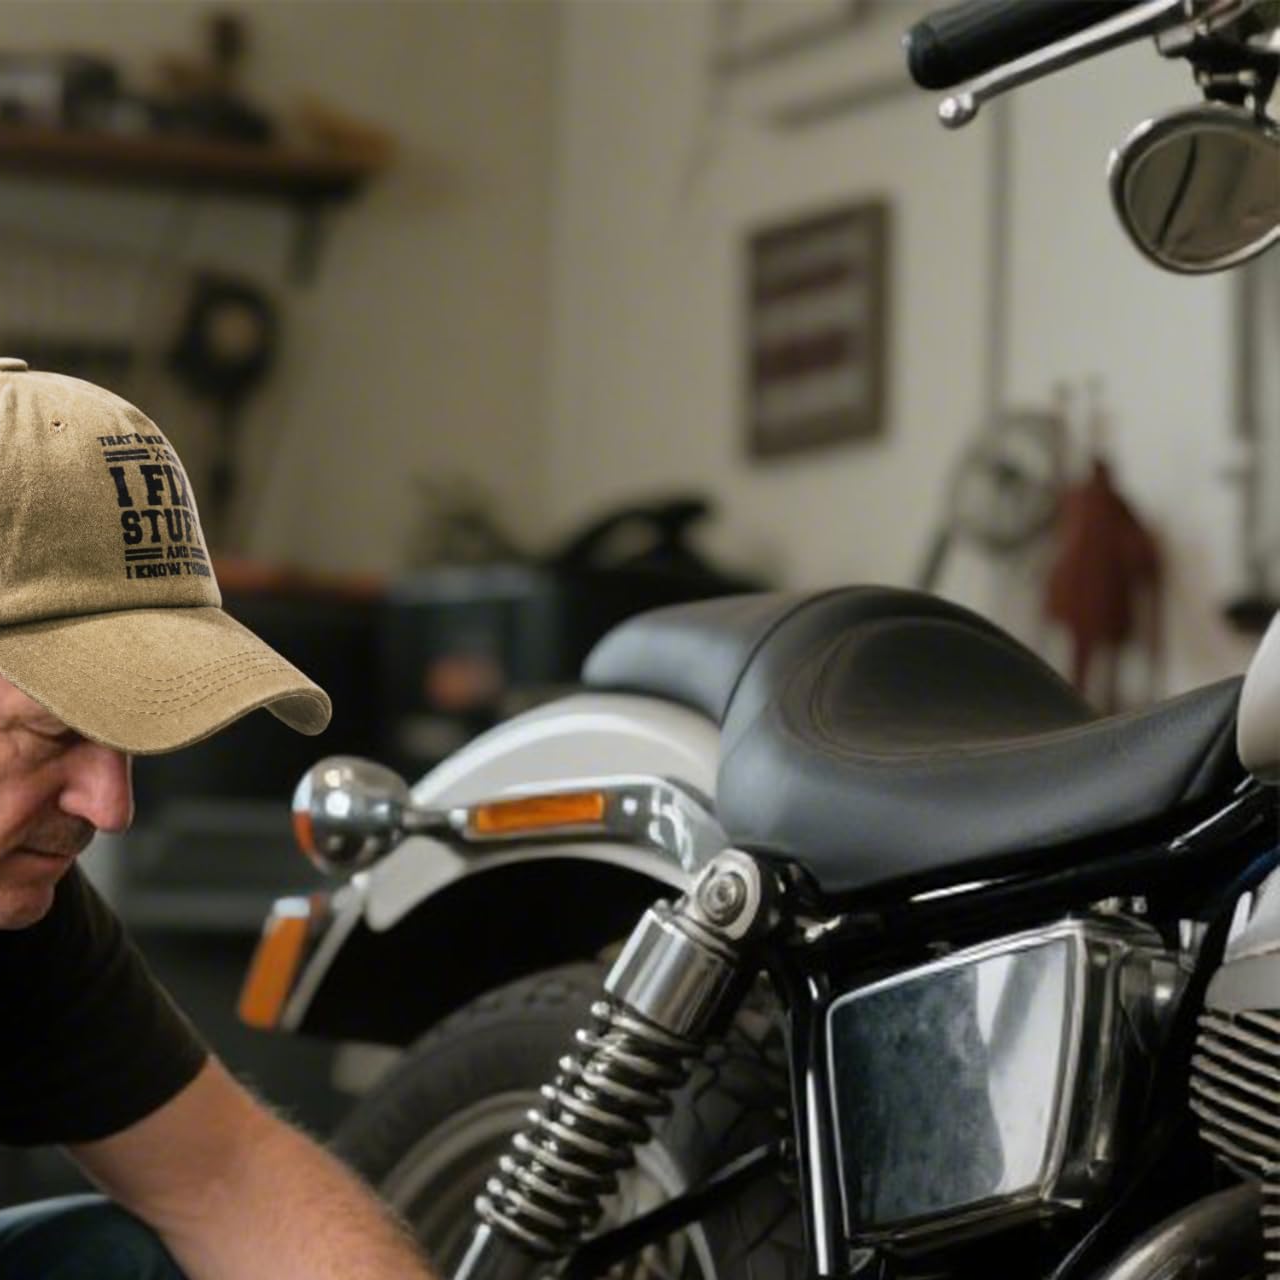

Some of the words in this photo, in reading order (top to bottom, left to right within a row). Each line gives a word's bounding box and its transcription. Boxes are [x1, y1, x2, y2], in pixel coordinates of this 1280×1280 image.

[109, 466, 133, 507] I
[167, 546, 189, 559] AND
[126, 565, 133, 579] I
[135, 562, 182, 578] KNOW
